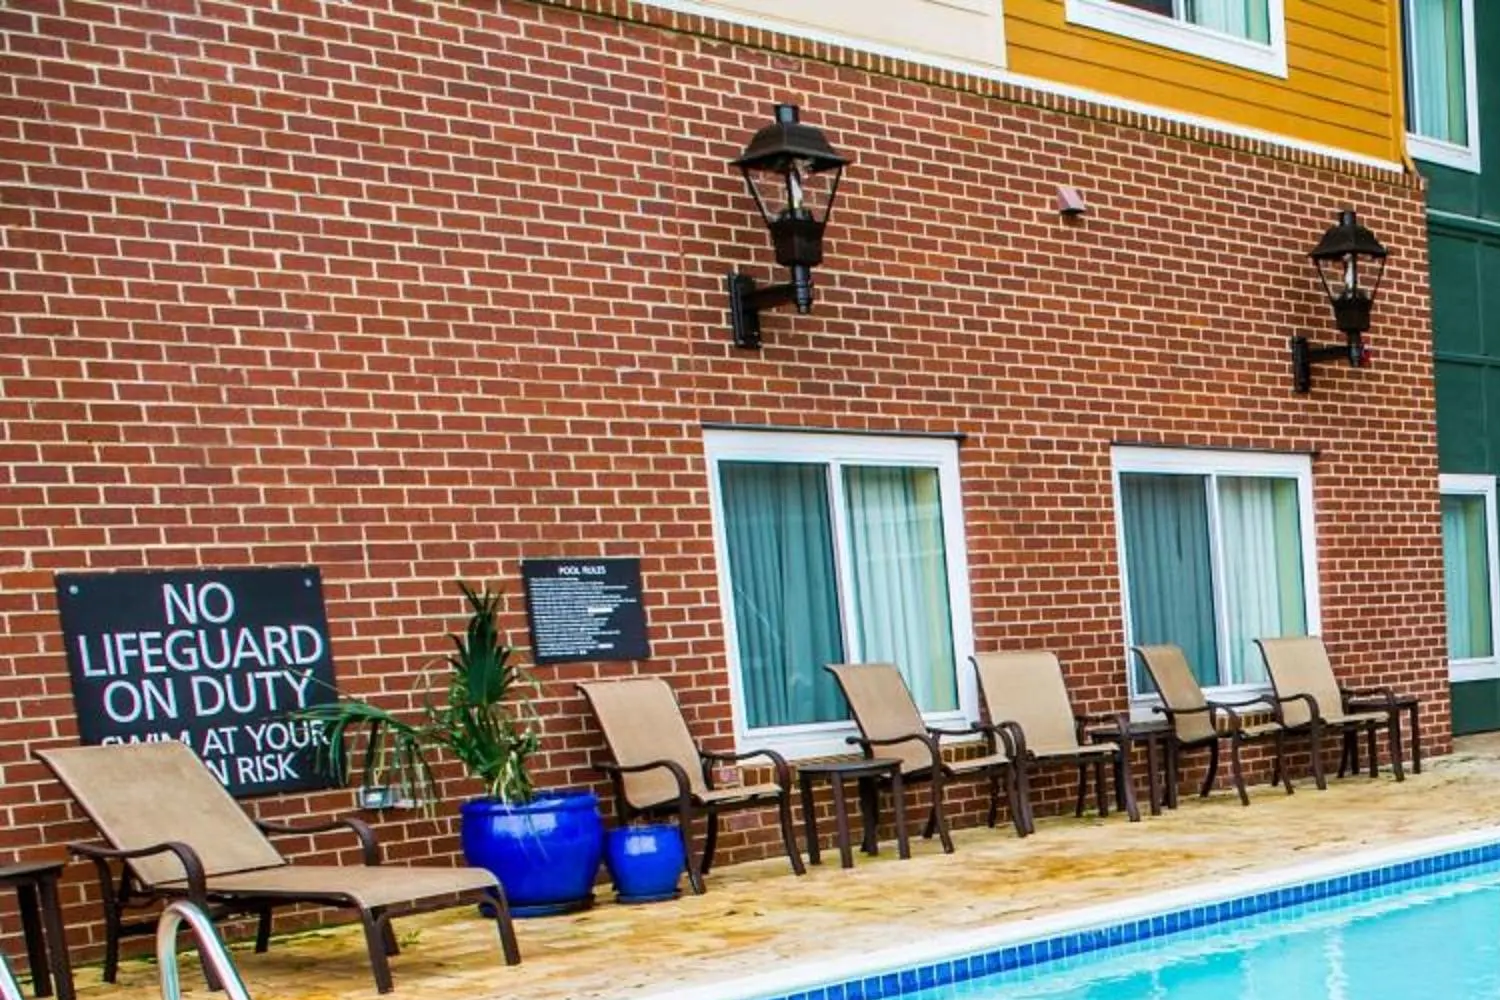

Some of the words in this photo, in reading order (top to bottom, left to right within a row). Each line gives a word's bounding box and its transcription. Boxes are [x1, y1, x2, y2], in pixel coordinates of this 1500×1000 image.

[558, 565, 580, 575] POOL
[162, 581, 234, 625] NO
[77, 624, 324, 677] LIFEGUARD
[103, 677, 178, 723] ON
[191, 669, 313, 716] DUTY
[202, 726, 238, 757] AT
[245, 719, 331, 752] YOUR
[237, 752, 299, 785] RISK
